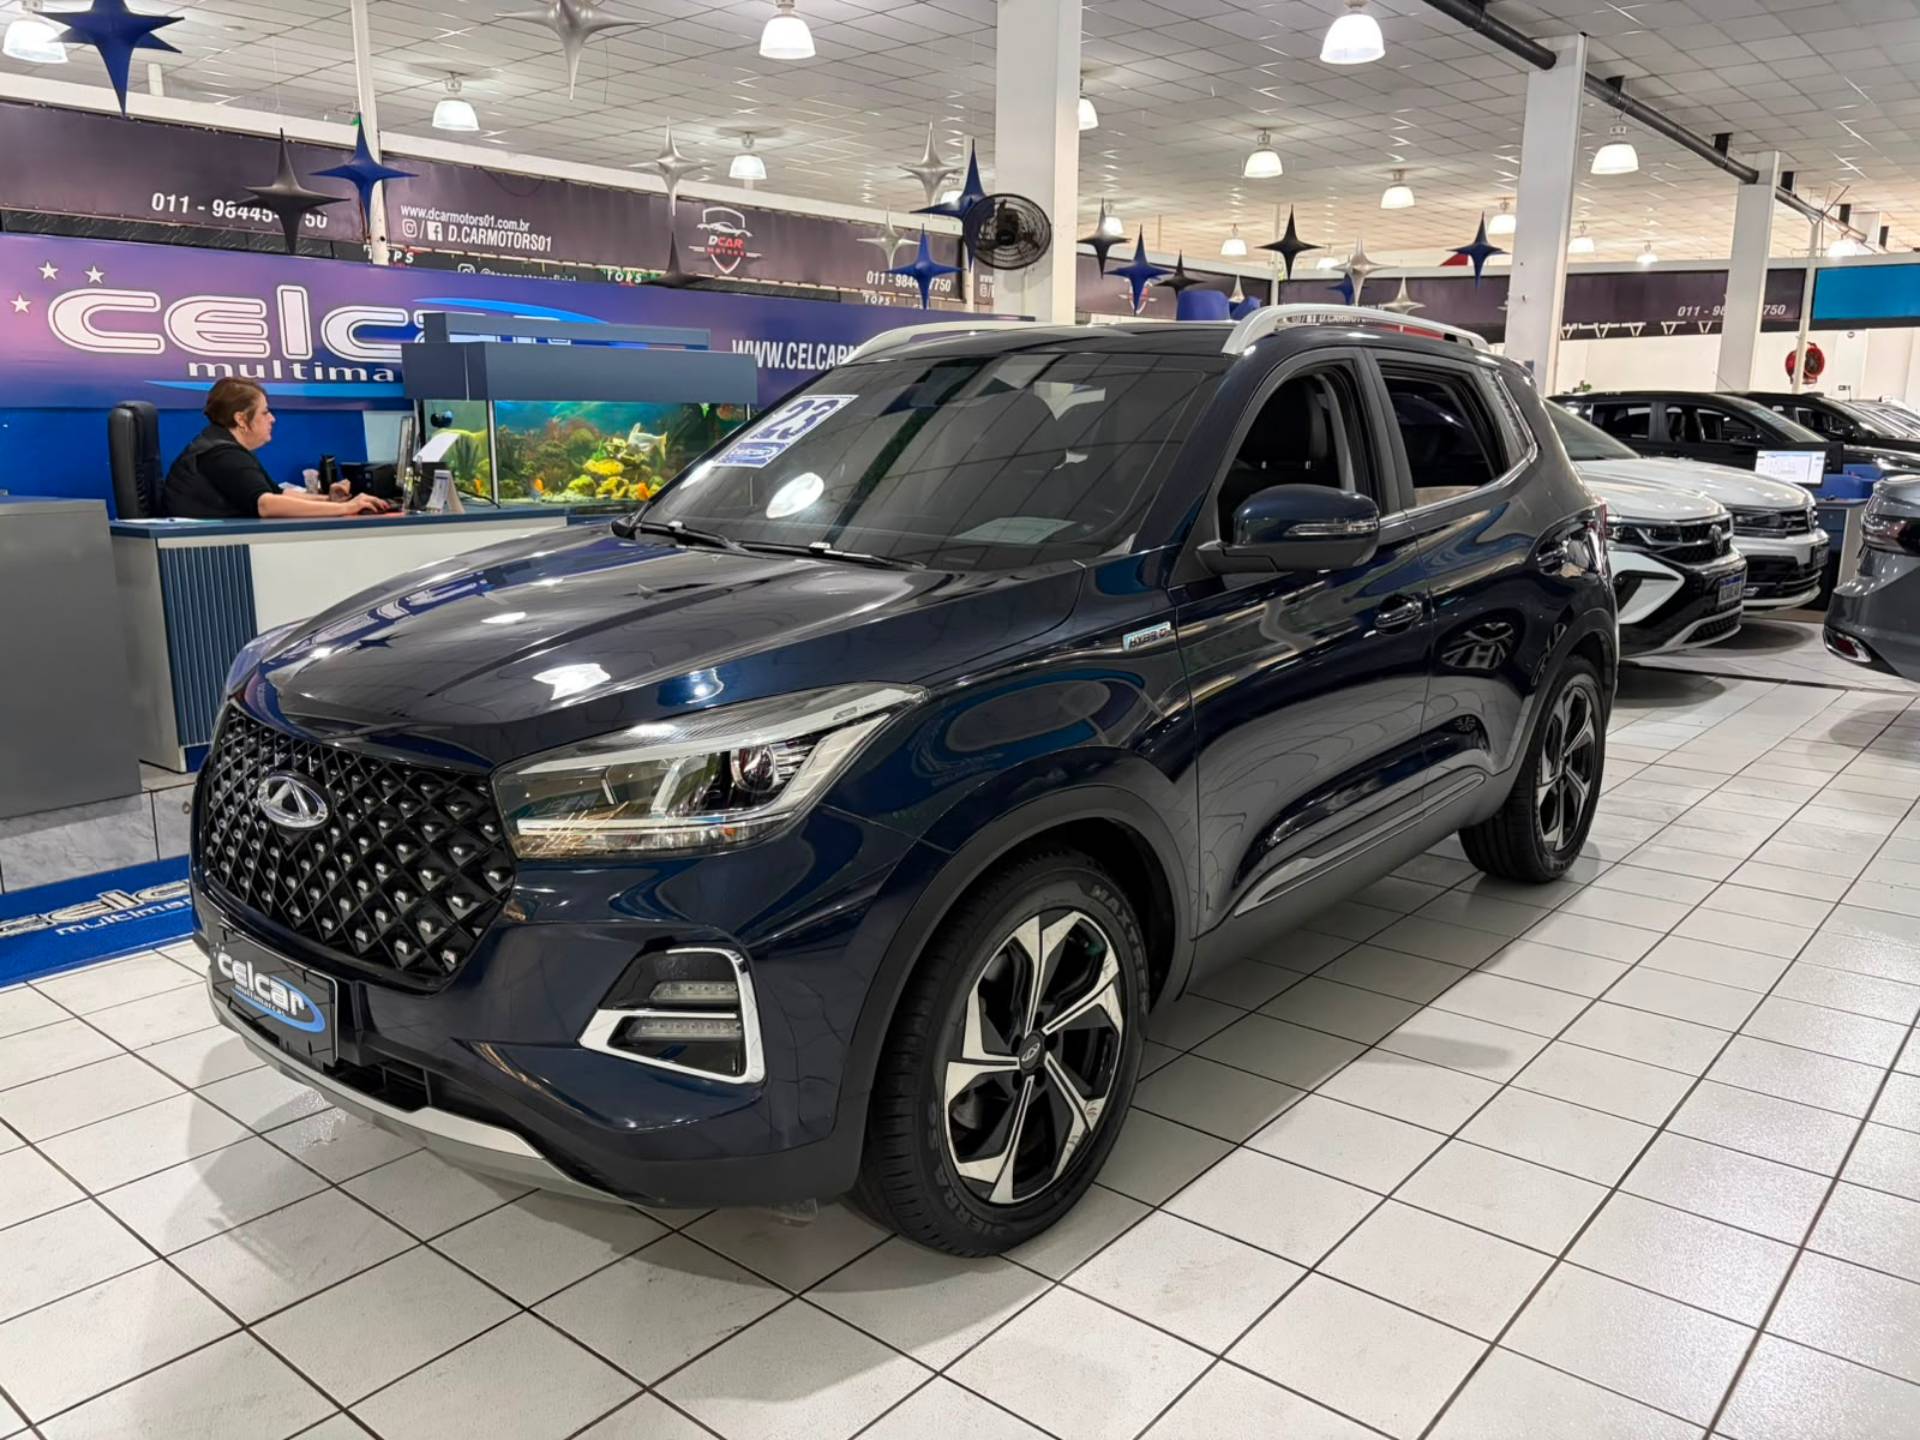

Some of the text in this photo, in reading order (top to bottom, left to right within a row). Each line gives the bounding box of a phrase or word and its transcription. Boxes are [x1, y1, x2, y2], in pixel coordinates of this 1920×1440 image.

[151, 192, 190, 214] 011
[197, 204, 206, 212] -
[401, 205, 530, 232] www.dcarmotors01.com.br
[448, 225, 552, 252] D.CARMOTORS01
[708, 235, 744, 249] DCAR
[866, 270, 885, 285] 011
[1677, 306, 1700, 317] 011
[188, 359, 396, 383] multima
[218, 951, 305, 1016] celcar
